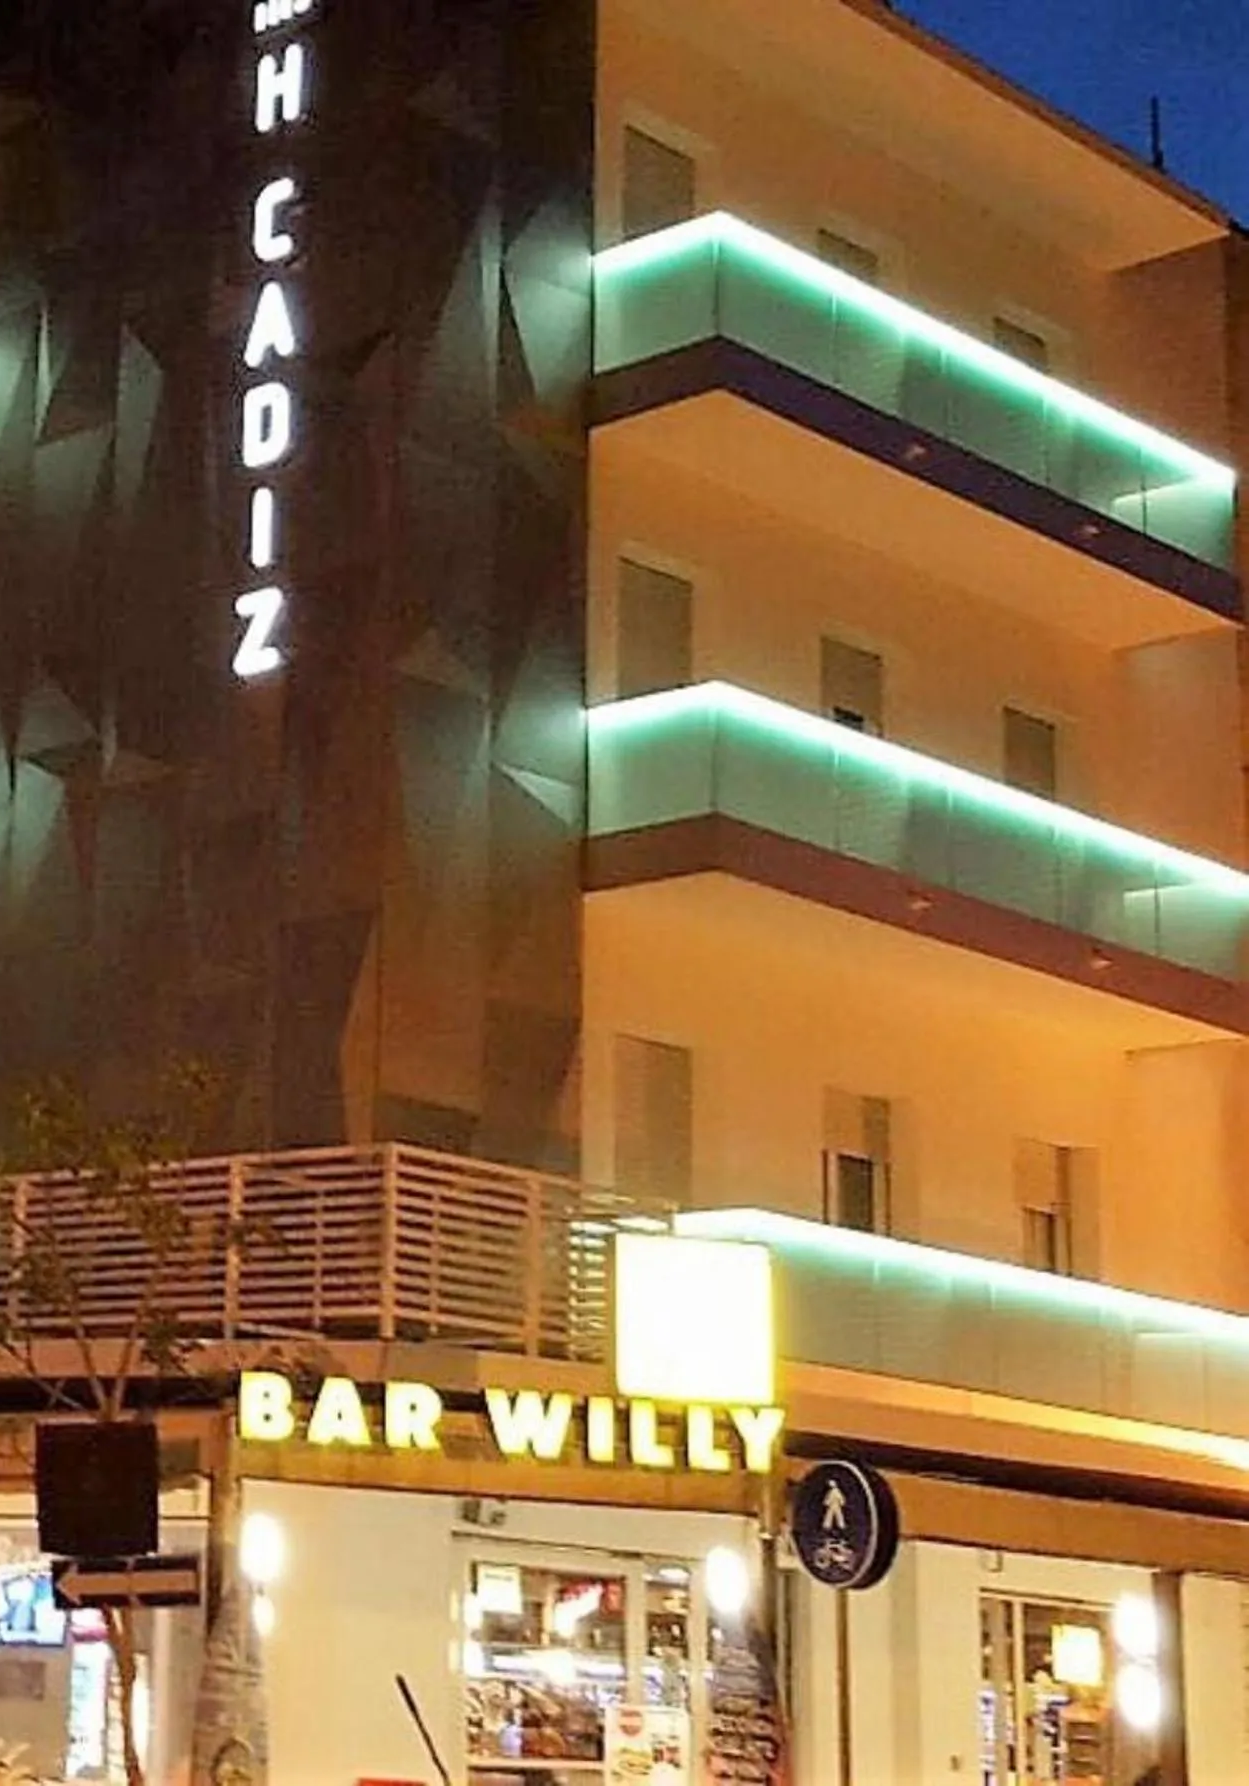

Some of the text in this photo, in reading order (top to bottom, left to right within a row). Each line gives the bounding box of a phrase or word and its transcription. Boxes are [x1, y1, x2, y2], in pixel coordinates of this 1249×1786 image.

[257, 44, 303, 134] H
[232, 177, 295, 677] CADIZ
[239, 1370, 786, 1474] BAR WILLY
